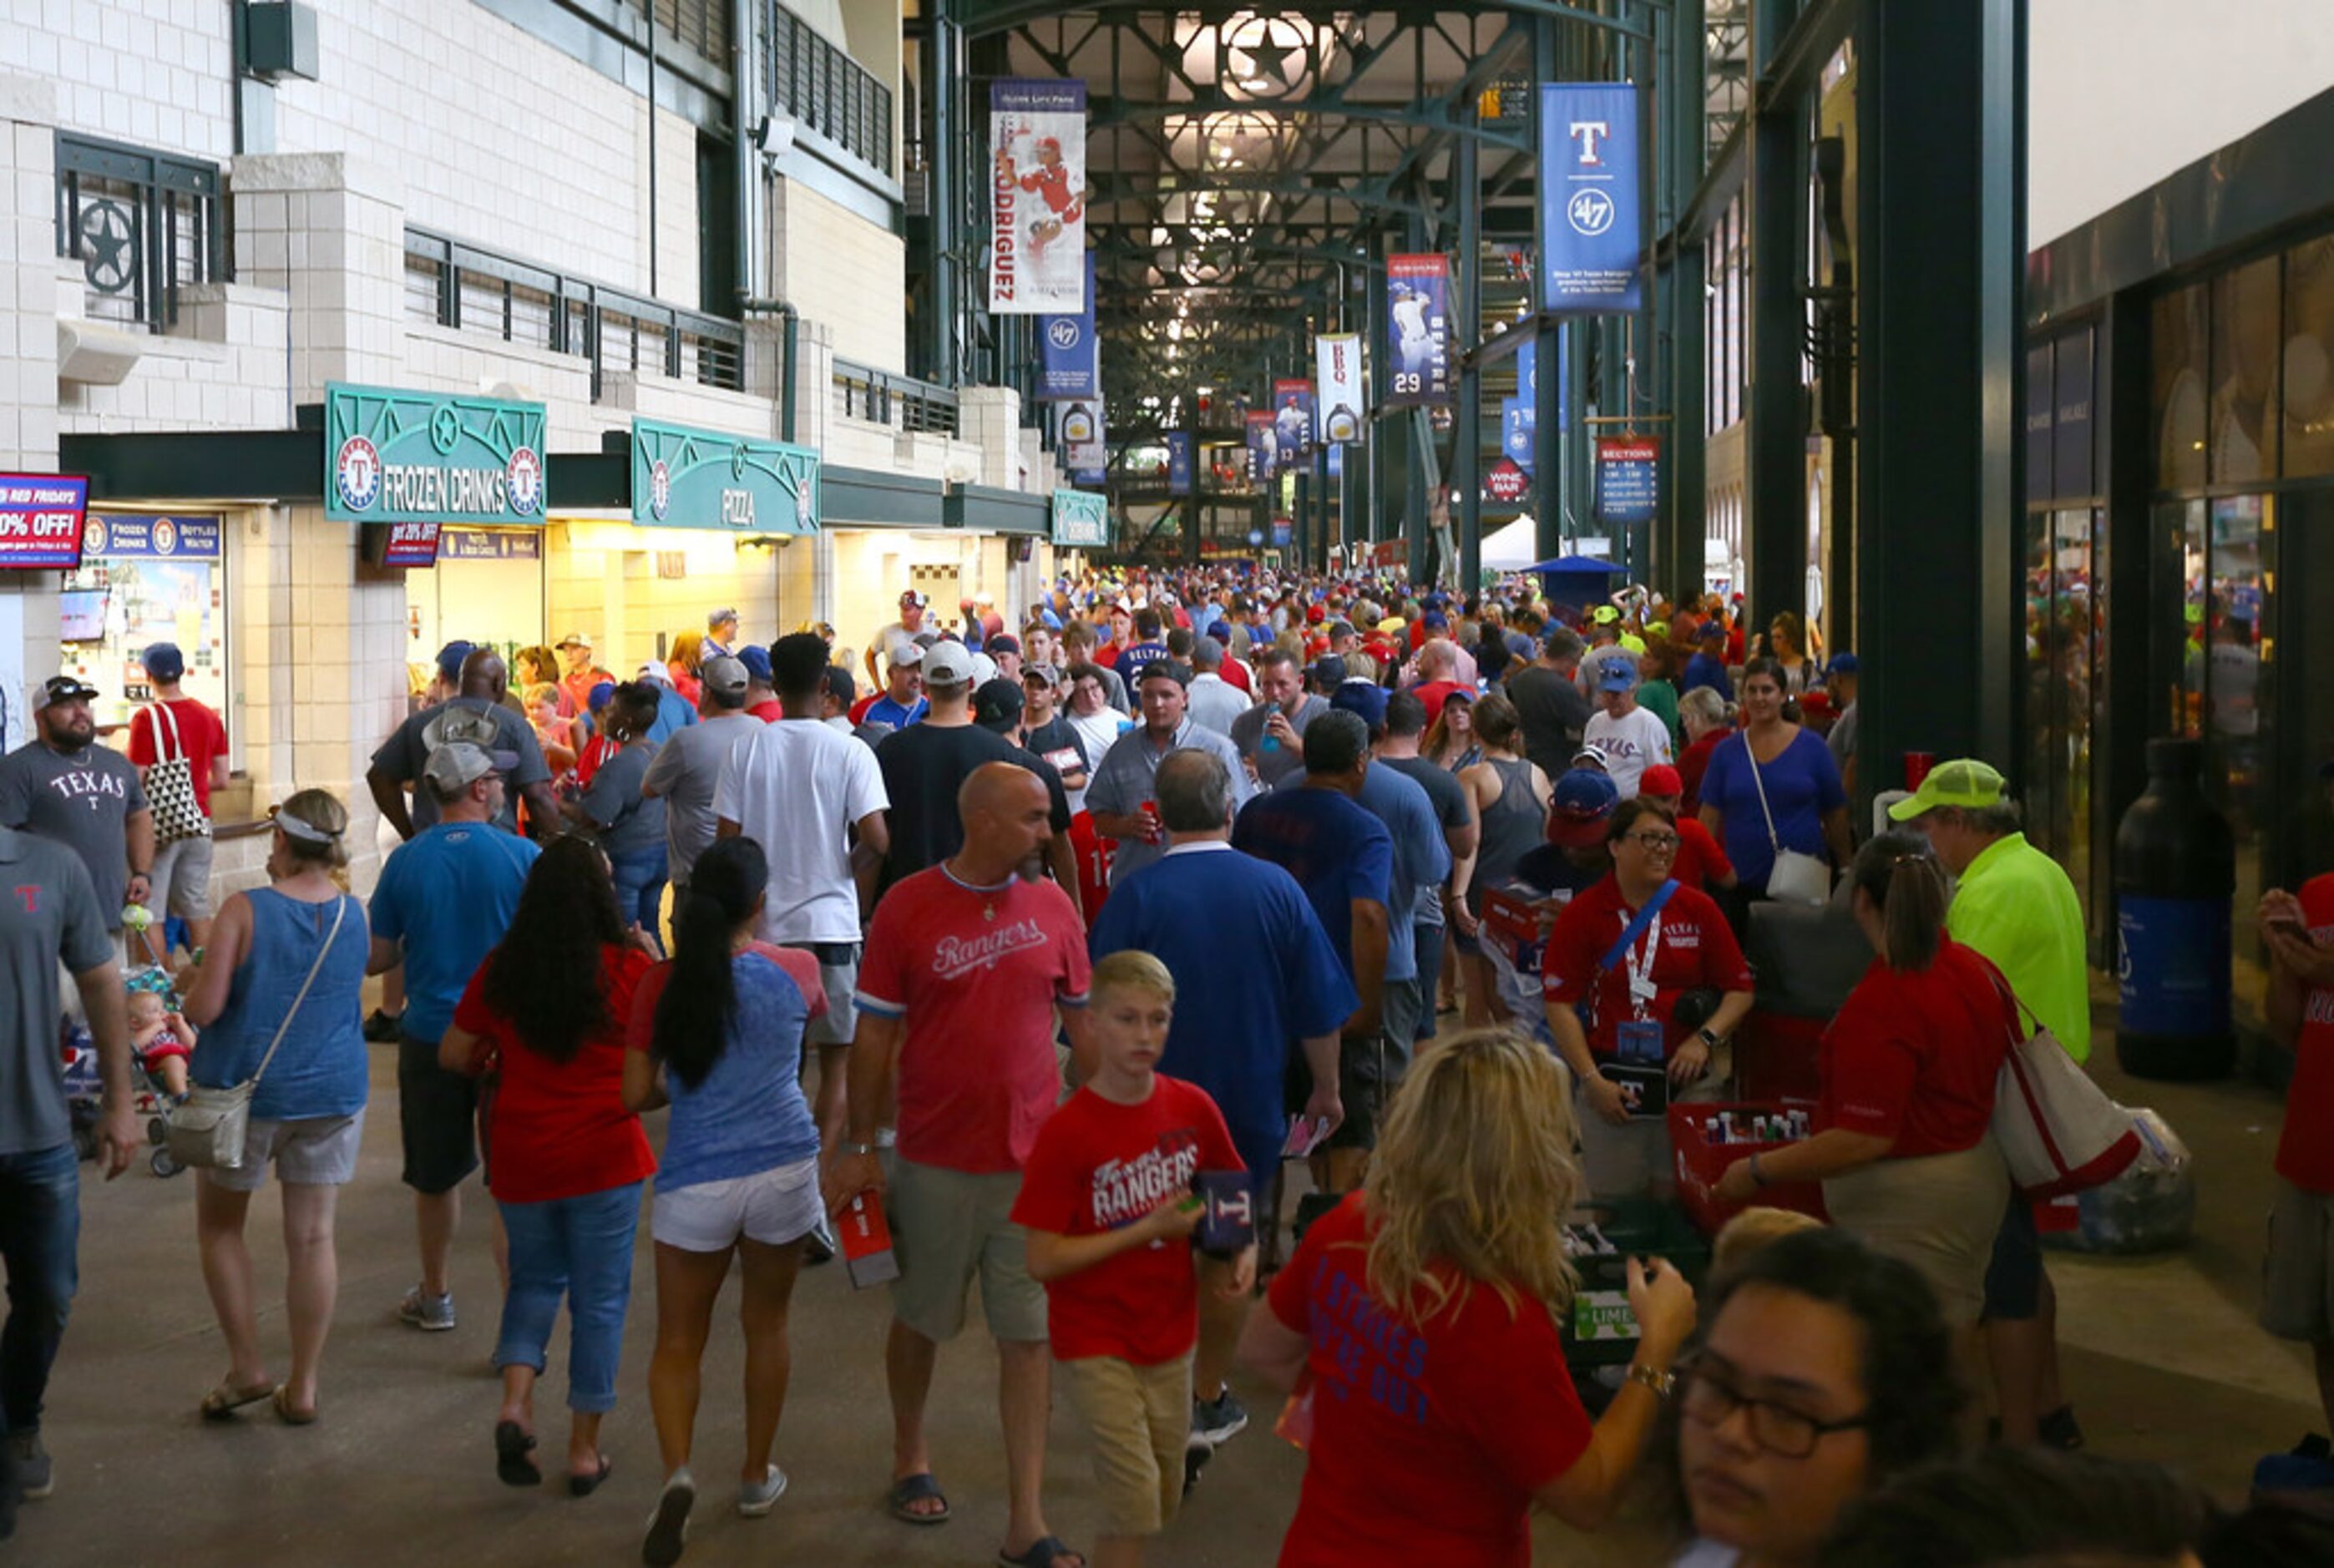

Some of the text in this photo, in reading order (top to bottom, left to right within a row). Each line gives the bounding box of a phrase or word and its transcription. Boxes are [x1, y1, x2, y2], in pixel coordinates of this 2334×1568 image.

[1570, 121, 1610, 165] T
[1395, 373, 1420, 393] 29
[1602, 449, 1653, 459] SECTIONS
[382, 464, 505, 514] FROZEN DRINKS
[1490, 469, 1521, 483] WINE
[1493, 481, 1519, 494] BAR
[721, 488, 756, 527] PIZZA
[33, 512, 75, 536] OFF!
[50, 771, 124, 799] TEXAS
[88, 796, 99, 810] T
[13, 884, 42, 913] T
[932, 918, 1048, 973] Rangers
[1093, 1144, 1198, 1222] RANGERS
[1218, 1191, 1252, 1226] T
[1326, 1271, 1428, 1378] STRIKES
[1592, 1308, 1634, 1324] LIME
[1371, 1364, 1427, 1426] OUT
